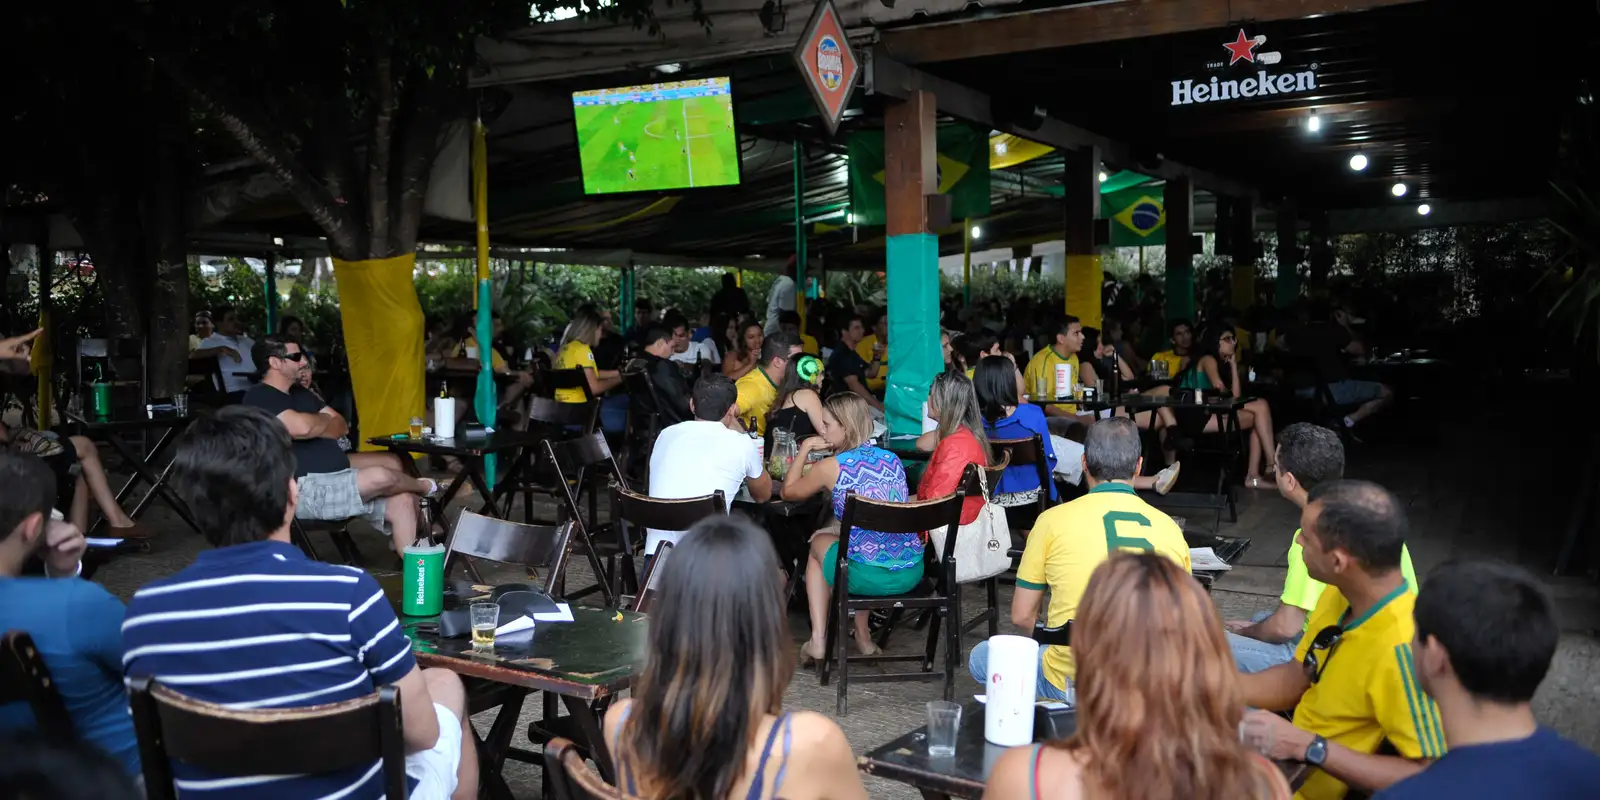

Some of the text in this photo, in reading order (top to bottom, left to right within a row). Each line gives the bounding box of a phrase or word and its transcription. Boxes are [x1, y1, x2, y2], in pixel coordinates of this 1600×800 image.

[1171, 70, 1316, 106] Heineken
[1103, 510, 1155, 555] 6
[416, 567, 425, 605] Heineken
